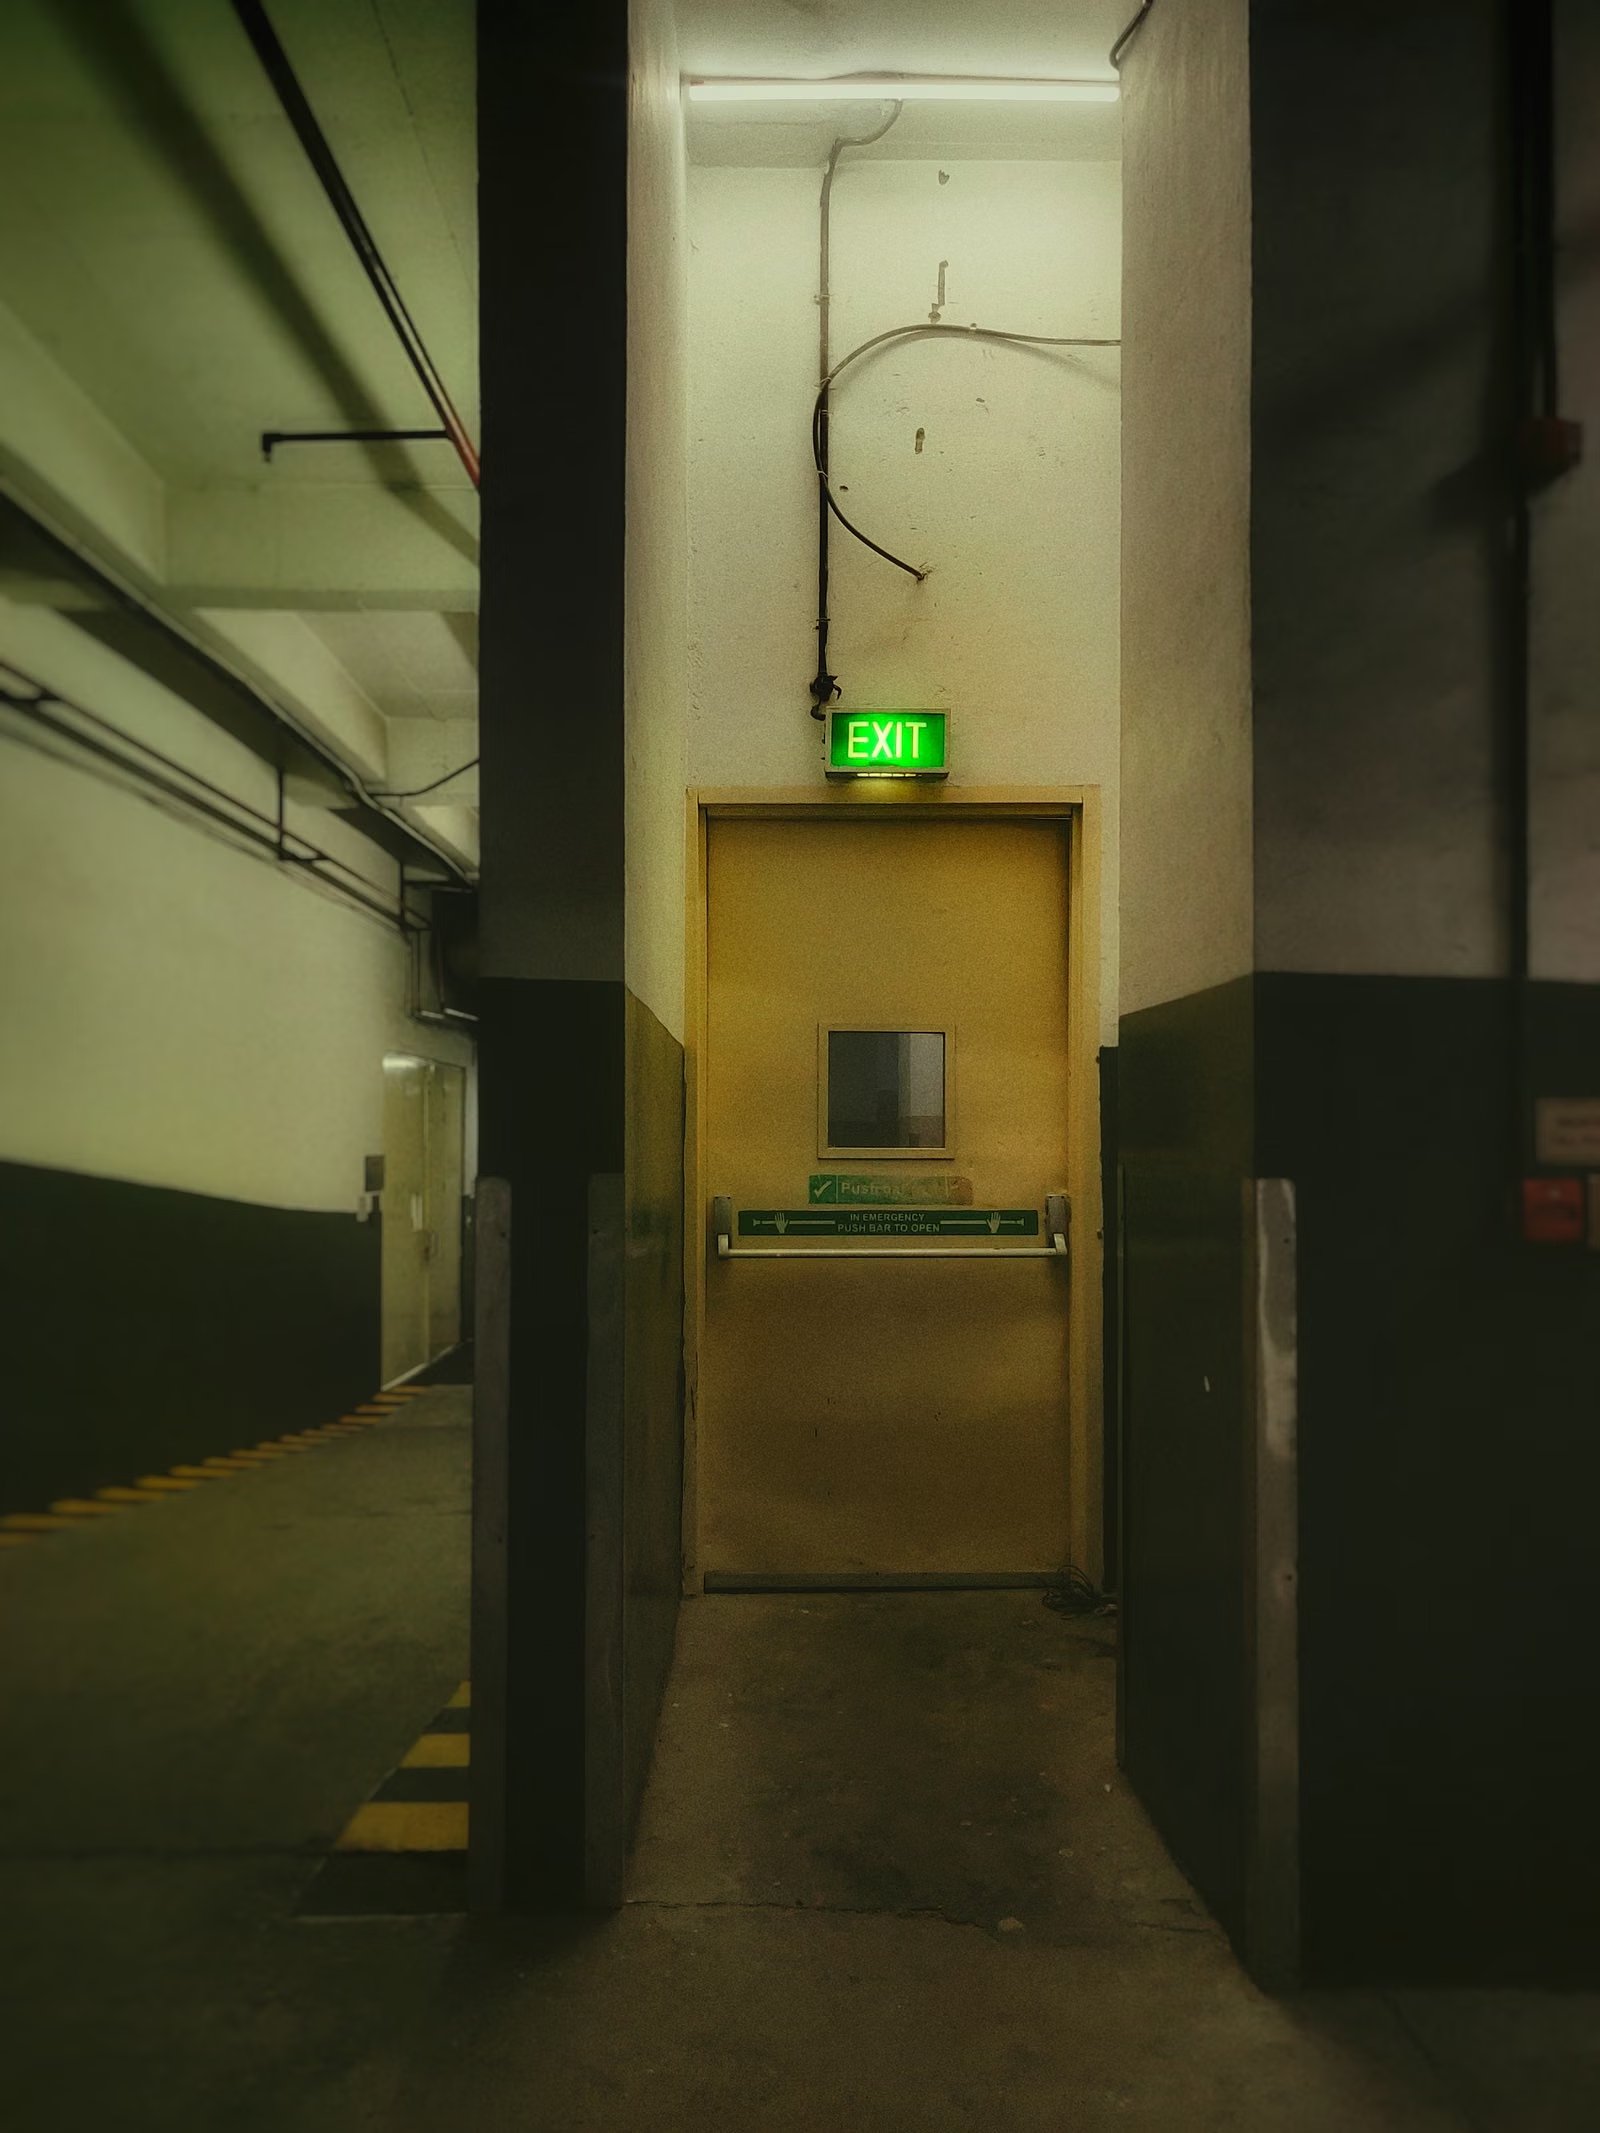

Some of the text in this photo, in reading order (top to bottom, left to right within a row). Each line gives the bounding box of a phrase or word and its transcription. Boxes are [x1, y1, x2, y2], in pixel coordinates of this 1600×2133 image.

[848, 721, 927, 758] EXIT
[850, 1213, 925, 1222] IN EMERGENCY
[838, 1223, 940, 1233] PUSH BAR TO OPEN
